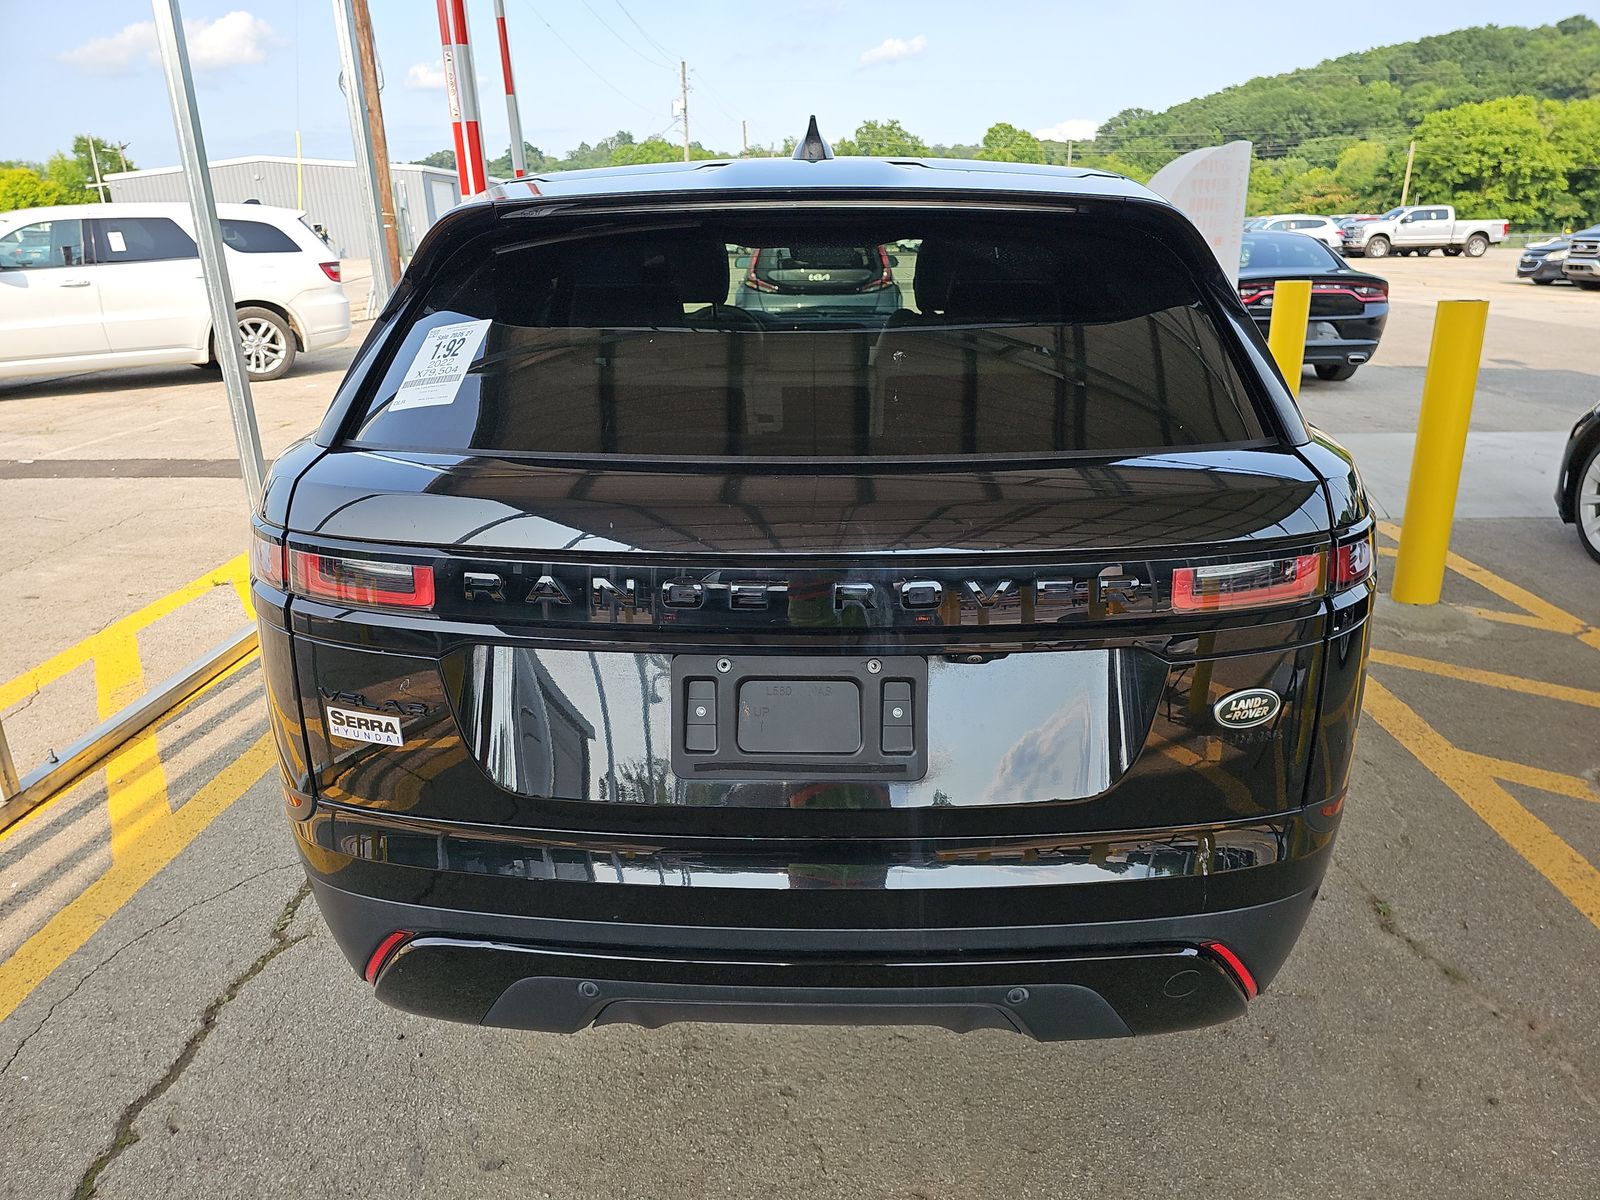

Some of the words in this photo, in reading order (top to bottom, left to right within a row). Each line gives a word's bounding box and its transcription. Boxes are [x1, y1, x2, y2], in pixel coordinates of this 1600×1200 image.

[430, 338, 466, 360] 1:92
[427, 358, 455, 368] 2022
[463, 572, 769, 611] RANGE
[832, 576, 1140, 611] ROVER
[318, 686, 429, 716] VELAR
[1230, 697, 1262, 711] LAND
[330, 710, 398, 735] SERRA
[1231, 706, 1270, 721] ROVER
[333, 726, 401, 744] HYUNDAI
